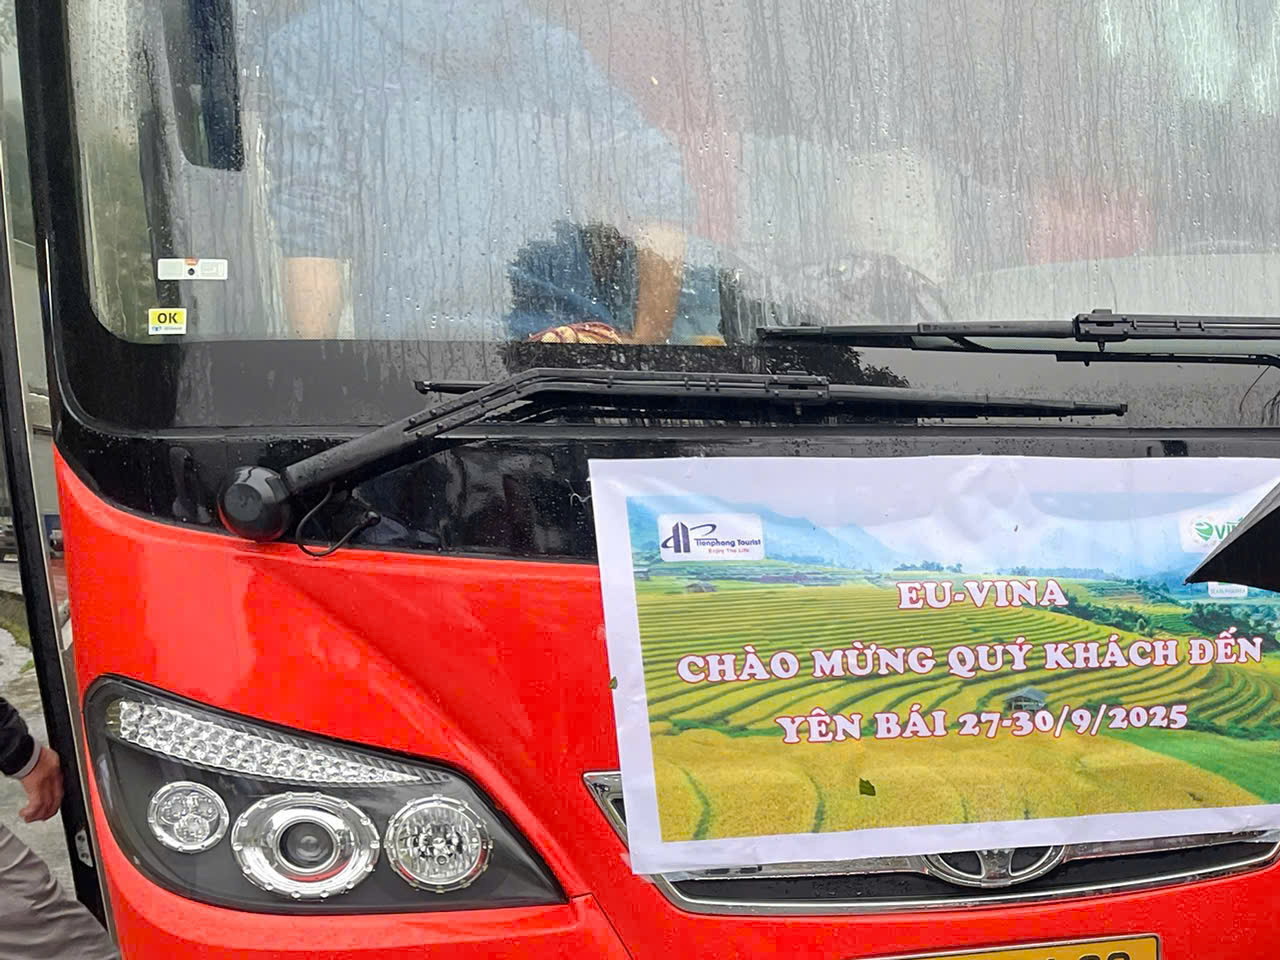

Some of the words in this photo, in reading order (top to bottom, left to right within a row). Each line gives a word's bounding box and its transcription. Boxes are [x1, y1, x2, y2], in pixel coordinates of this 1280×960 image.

[157, 312, 178, 324] OK
[896, 579, 1069, 609] EU-VINA
[676, 644, 800, 683] CHÀO
[811, 640, 937, 678] MỪNG
[947, 636, 1033, 679] QUÝ
[1043, 633, 1179, 670] KHÁCH
[1188, 626, 1263, 665] ĐẾN
[775, 706, 863, 744] YÊN
[874, 703, 948, 740] BÁI
[957, 703, 1189, 738] 27-30/9/2025
